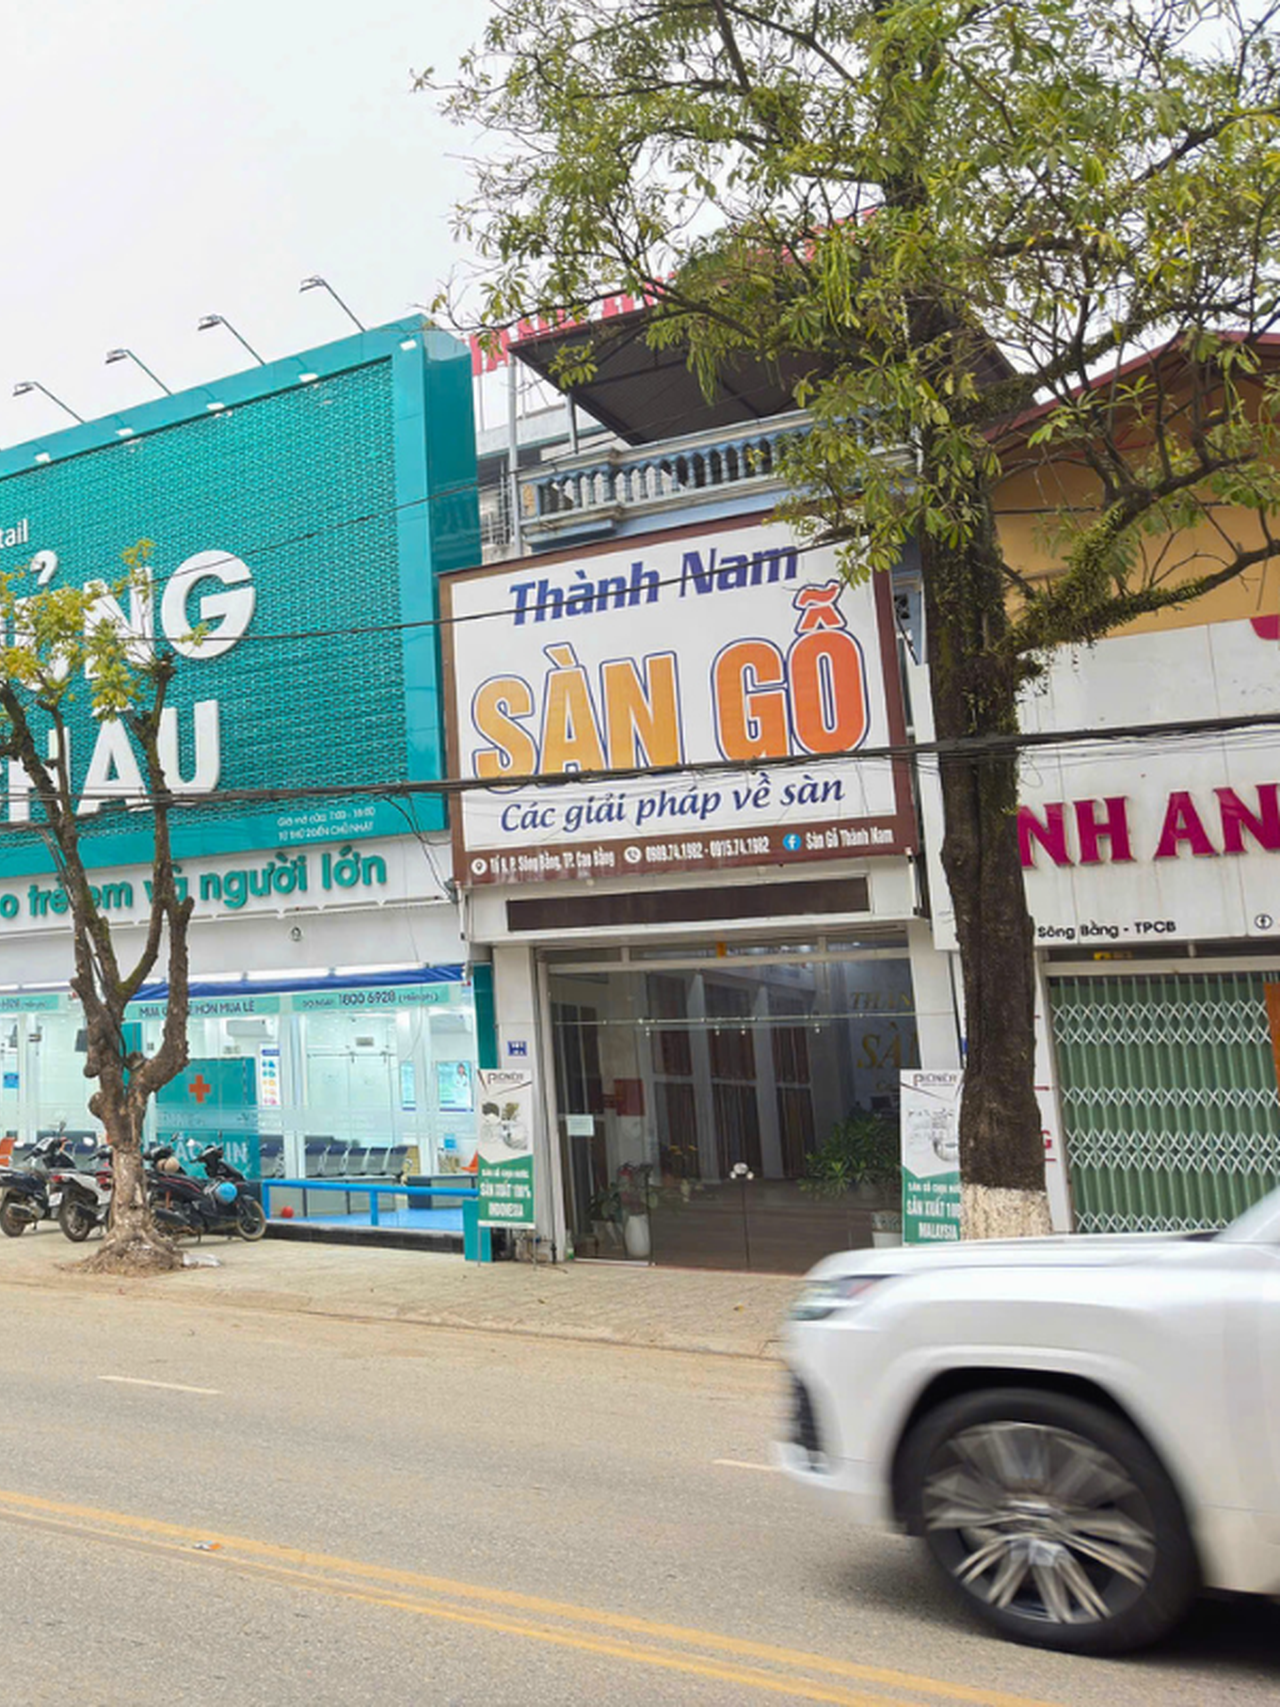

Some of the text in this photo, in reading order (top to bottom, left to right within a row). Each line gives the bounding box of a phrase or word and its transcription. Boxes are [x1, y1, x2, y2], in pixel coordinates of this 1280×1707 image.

[509, 544, 798, 626] Thành Nam
[472, 579, 869, 794] SÀN GỖ
[501, 772, 845, 832] Các giải pháp về sàn
[1154, 784, 1280, 860] AN
[200, 852, 308, 908] người
[322, 845, 388, 891] lớn
[1037, 924, 1076, 940] Sông
[1079, 919, 1119, 939] Bằng
[1134, 921, 1176, 934] TPCB
[338, 993, 365, 1006] 1800
[366, 990, 396, 1004] 6928
[918, 1221, 959, 1241] MALAYSIA
